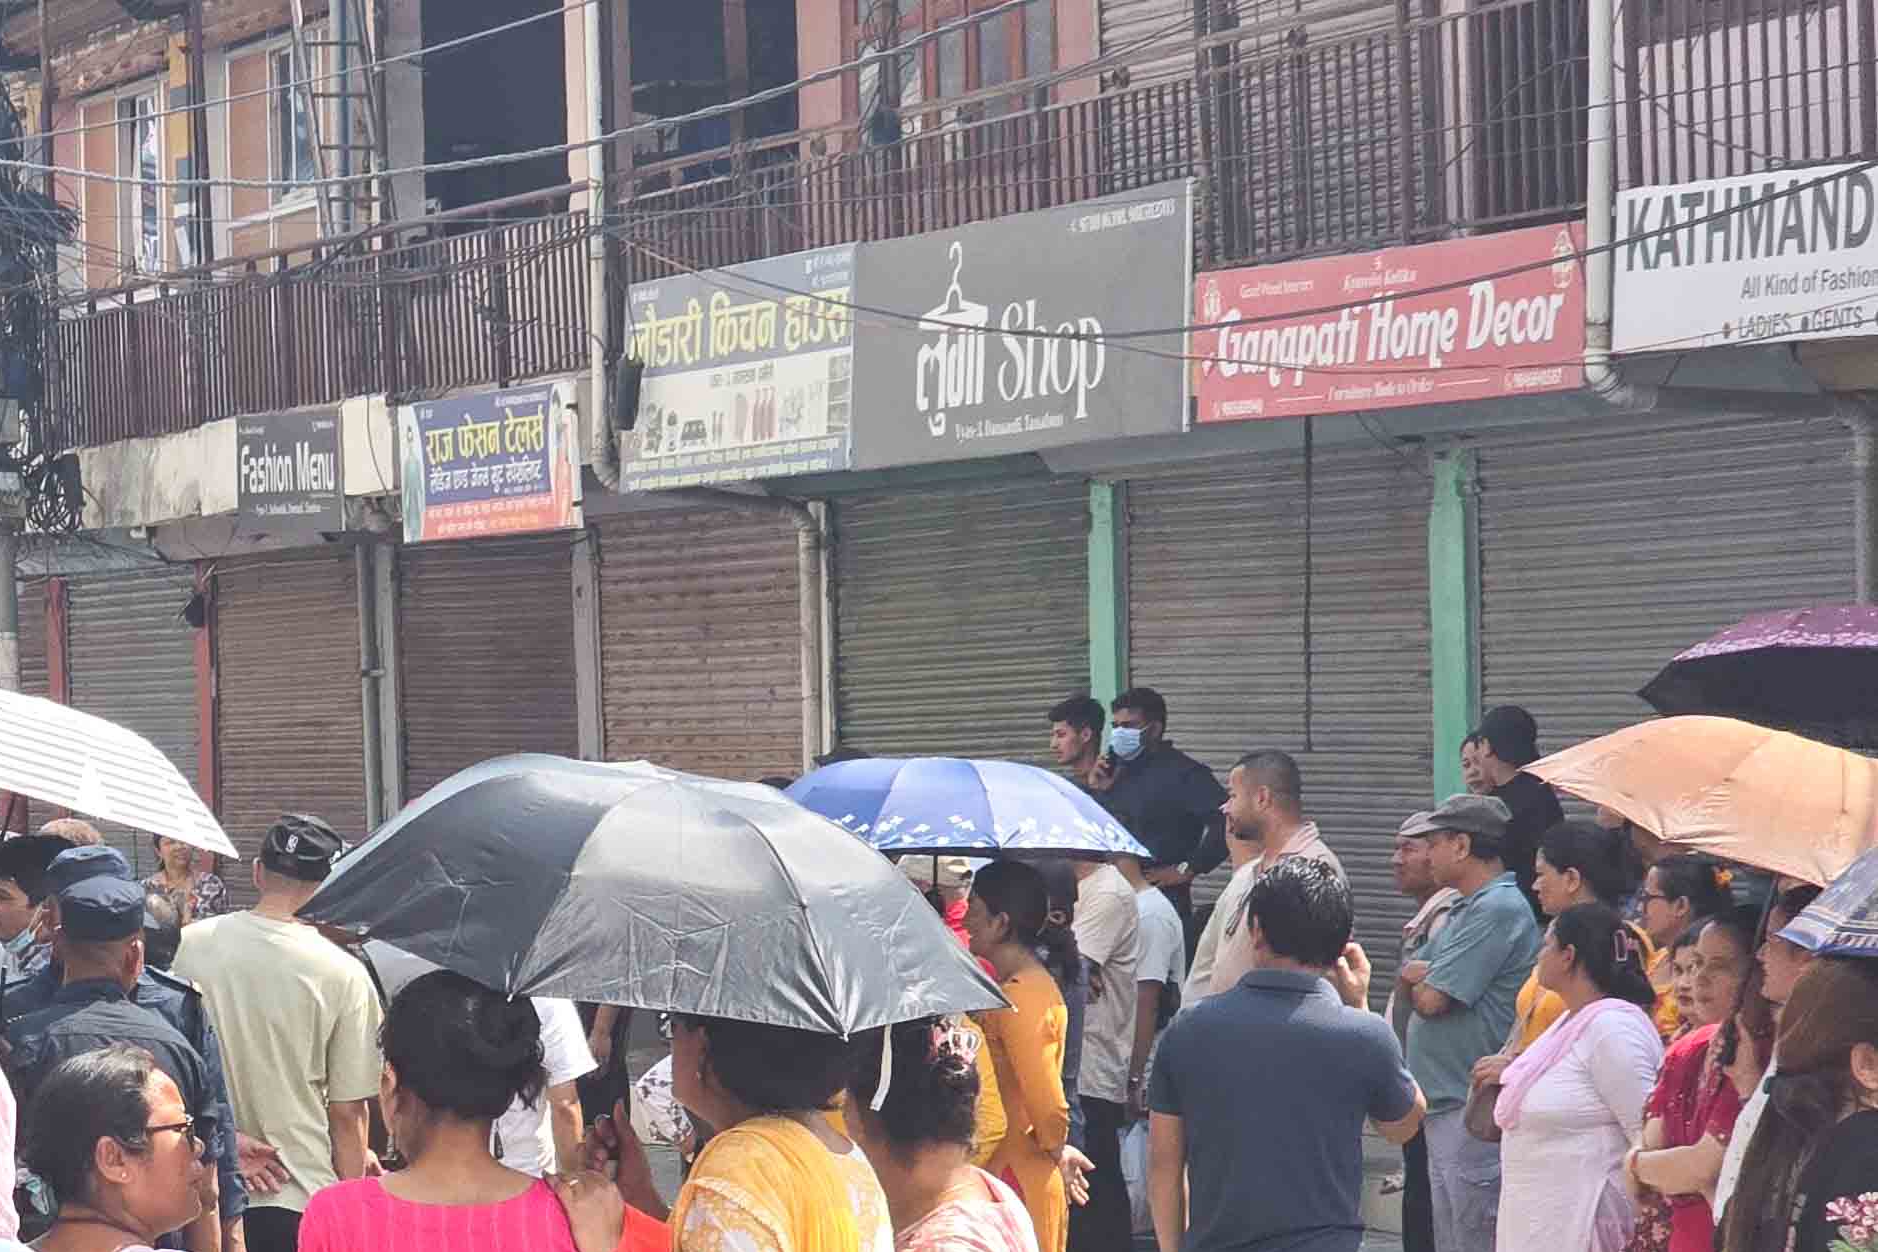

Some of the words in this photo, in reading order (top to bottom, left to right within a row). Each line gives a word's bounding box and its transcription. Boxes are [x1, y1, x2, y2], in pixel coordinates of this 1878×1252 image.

[1740, 275, 1760, 299] All
[1765, 271, 1798, 297] Kind
[1801, 270, 1818, 293] of
[1367, 290, 1459, 369] Home
[1466, 279, 1565, 350] Decor
[1738, 311, 1792, 339] LADIES
[1812, 305, 1863, 332] GENTS
[997, 299, 1106, 419] Shop
[241, 442, 293, 494] Fashion
[295, 440, 335, 491] Menu
